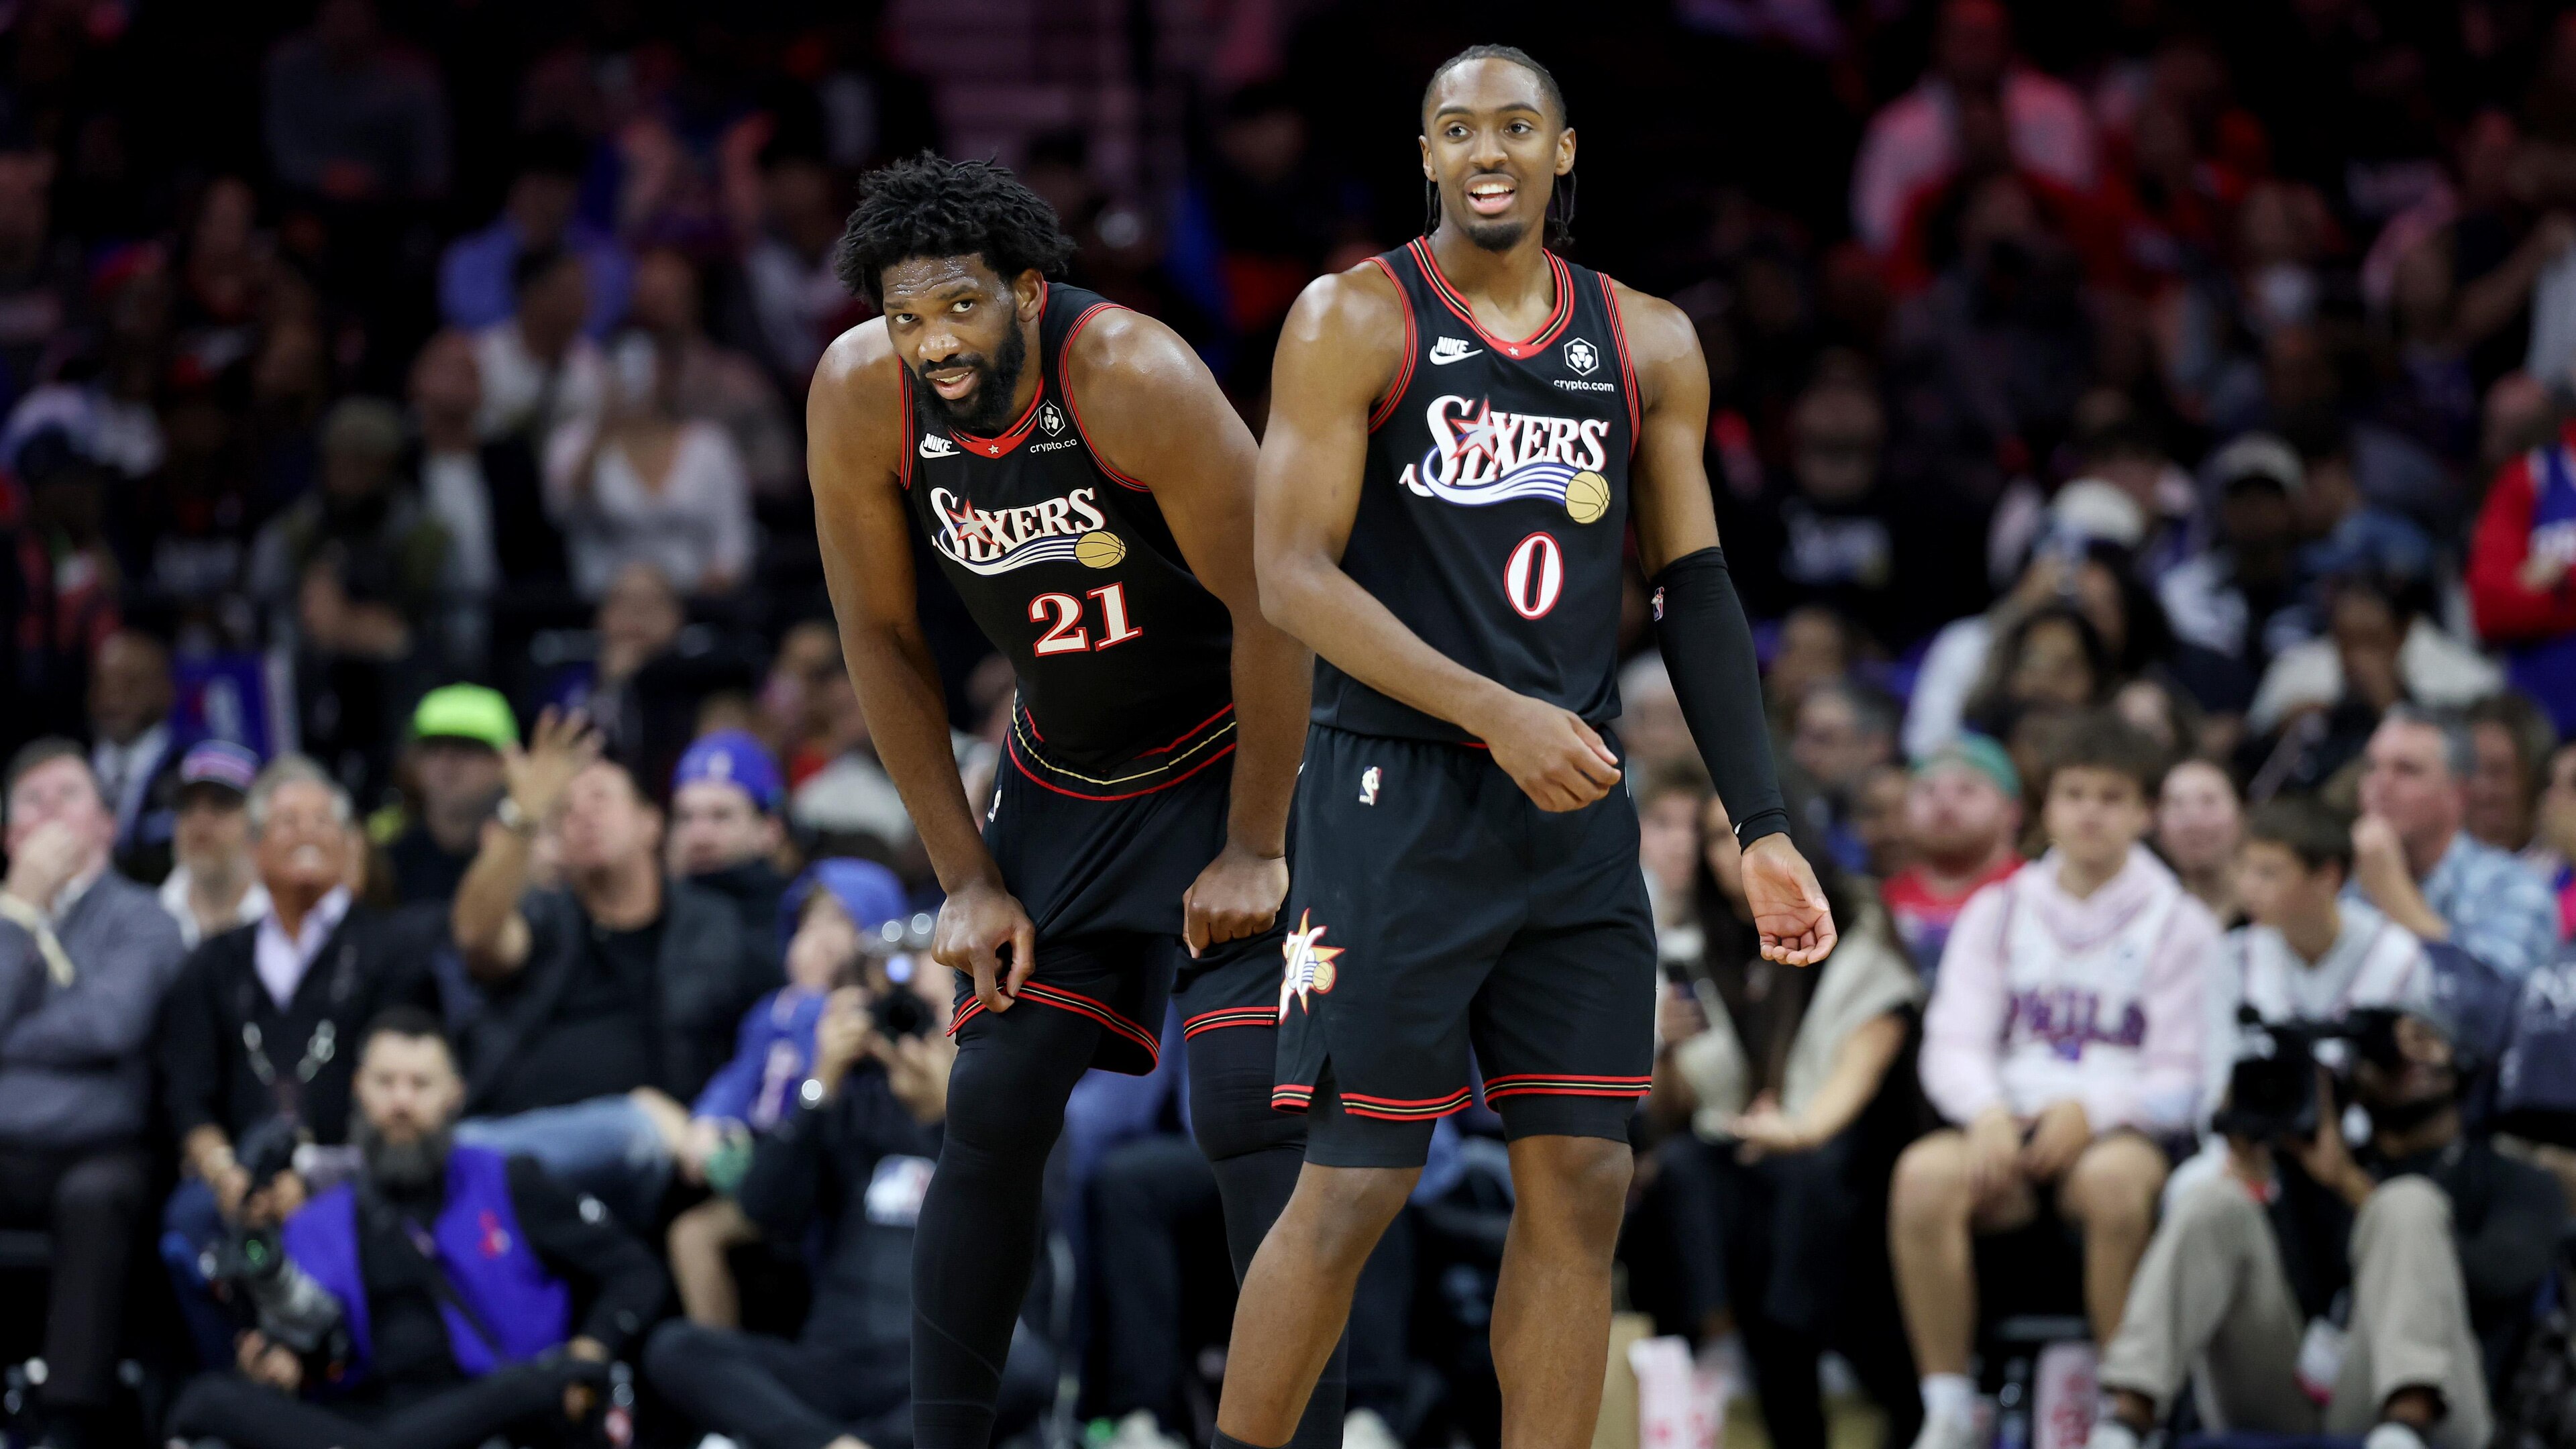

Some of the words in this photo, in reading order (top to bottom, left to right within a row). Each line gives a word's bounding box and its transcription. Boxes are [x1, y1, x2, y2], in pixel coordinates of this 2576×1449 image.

[1436, 336, 1469, 356] NIKE
[1554, 380, 1614, 392] crypto.com
[923, 433, 953, 453] NIKE
[1030, 439, 1077, 453] crypto.co
[1503, 531, 1564, 621] 0
[1028, 582, 1142, 657] 21
